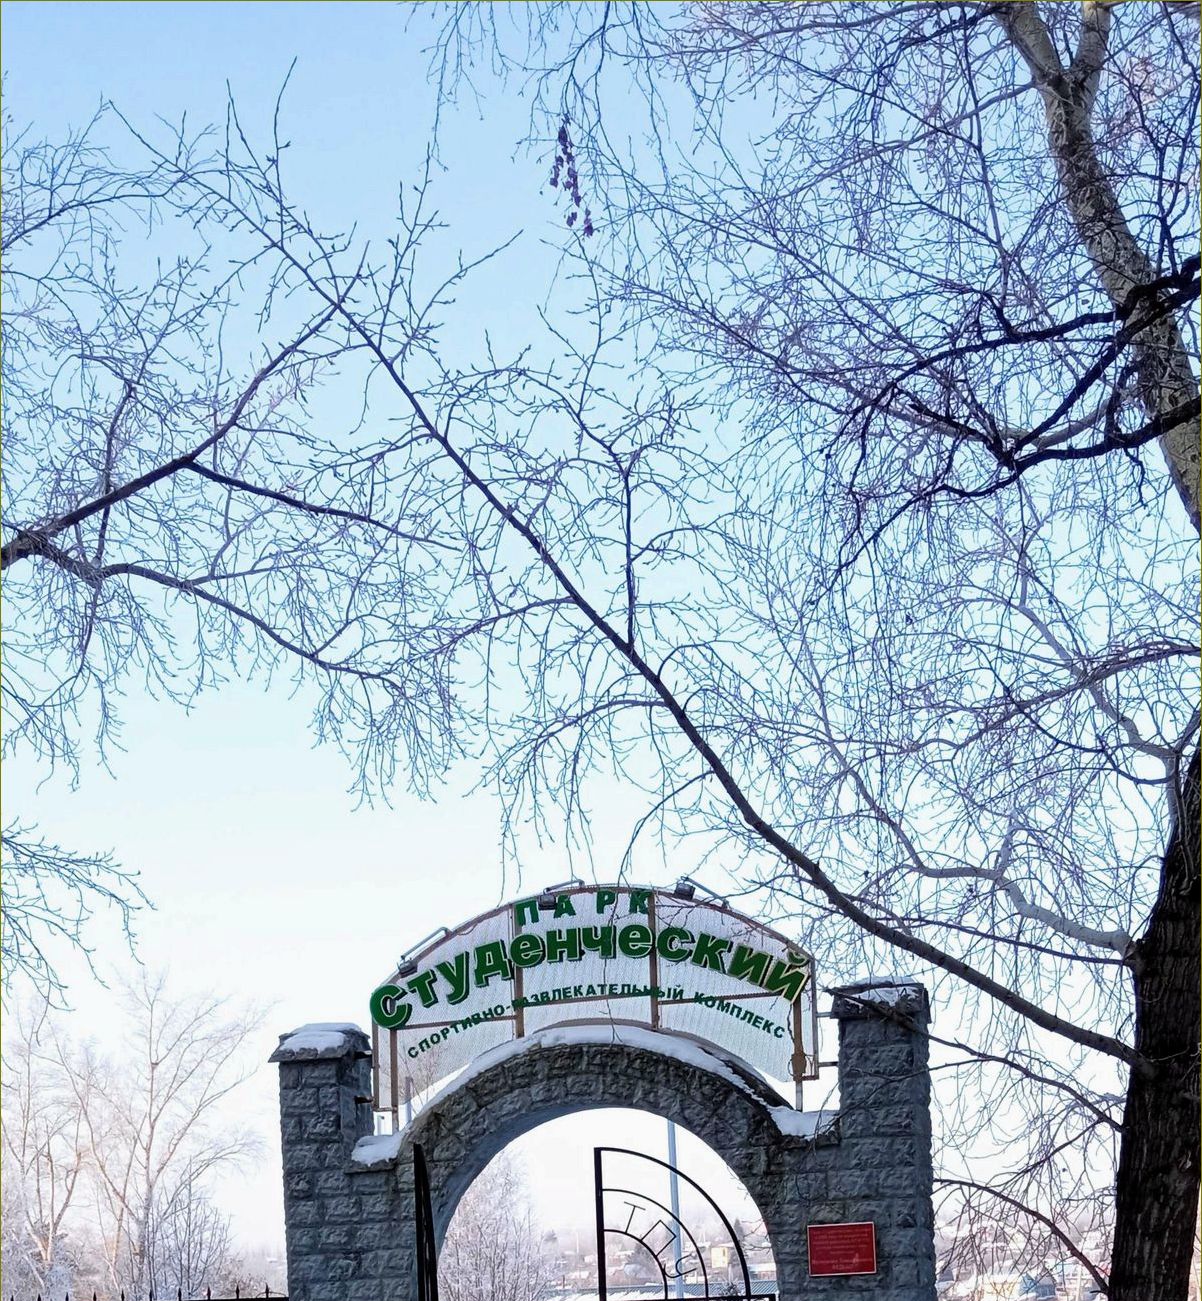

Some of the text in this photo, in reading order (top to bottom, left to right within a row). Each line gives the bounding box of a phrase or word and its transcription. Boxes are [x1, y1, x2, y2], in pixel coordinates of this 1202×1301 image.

[515, 890, 651, 926] ПАРК
[370, 924, 811, 1029] Студенческий
[693, 991, 786, 1039] КОМПЛЕКС
